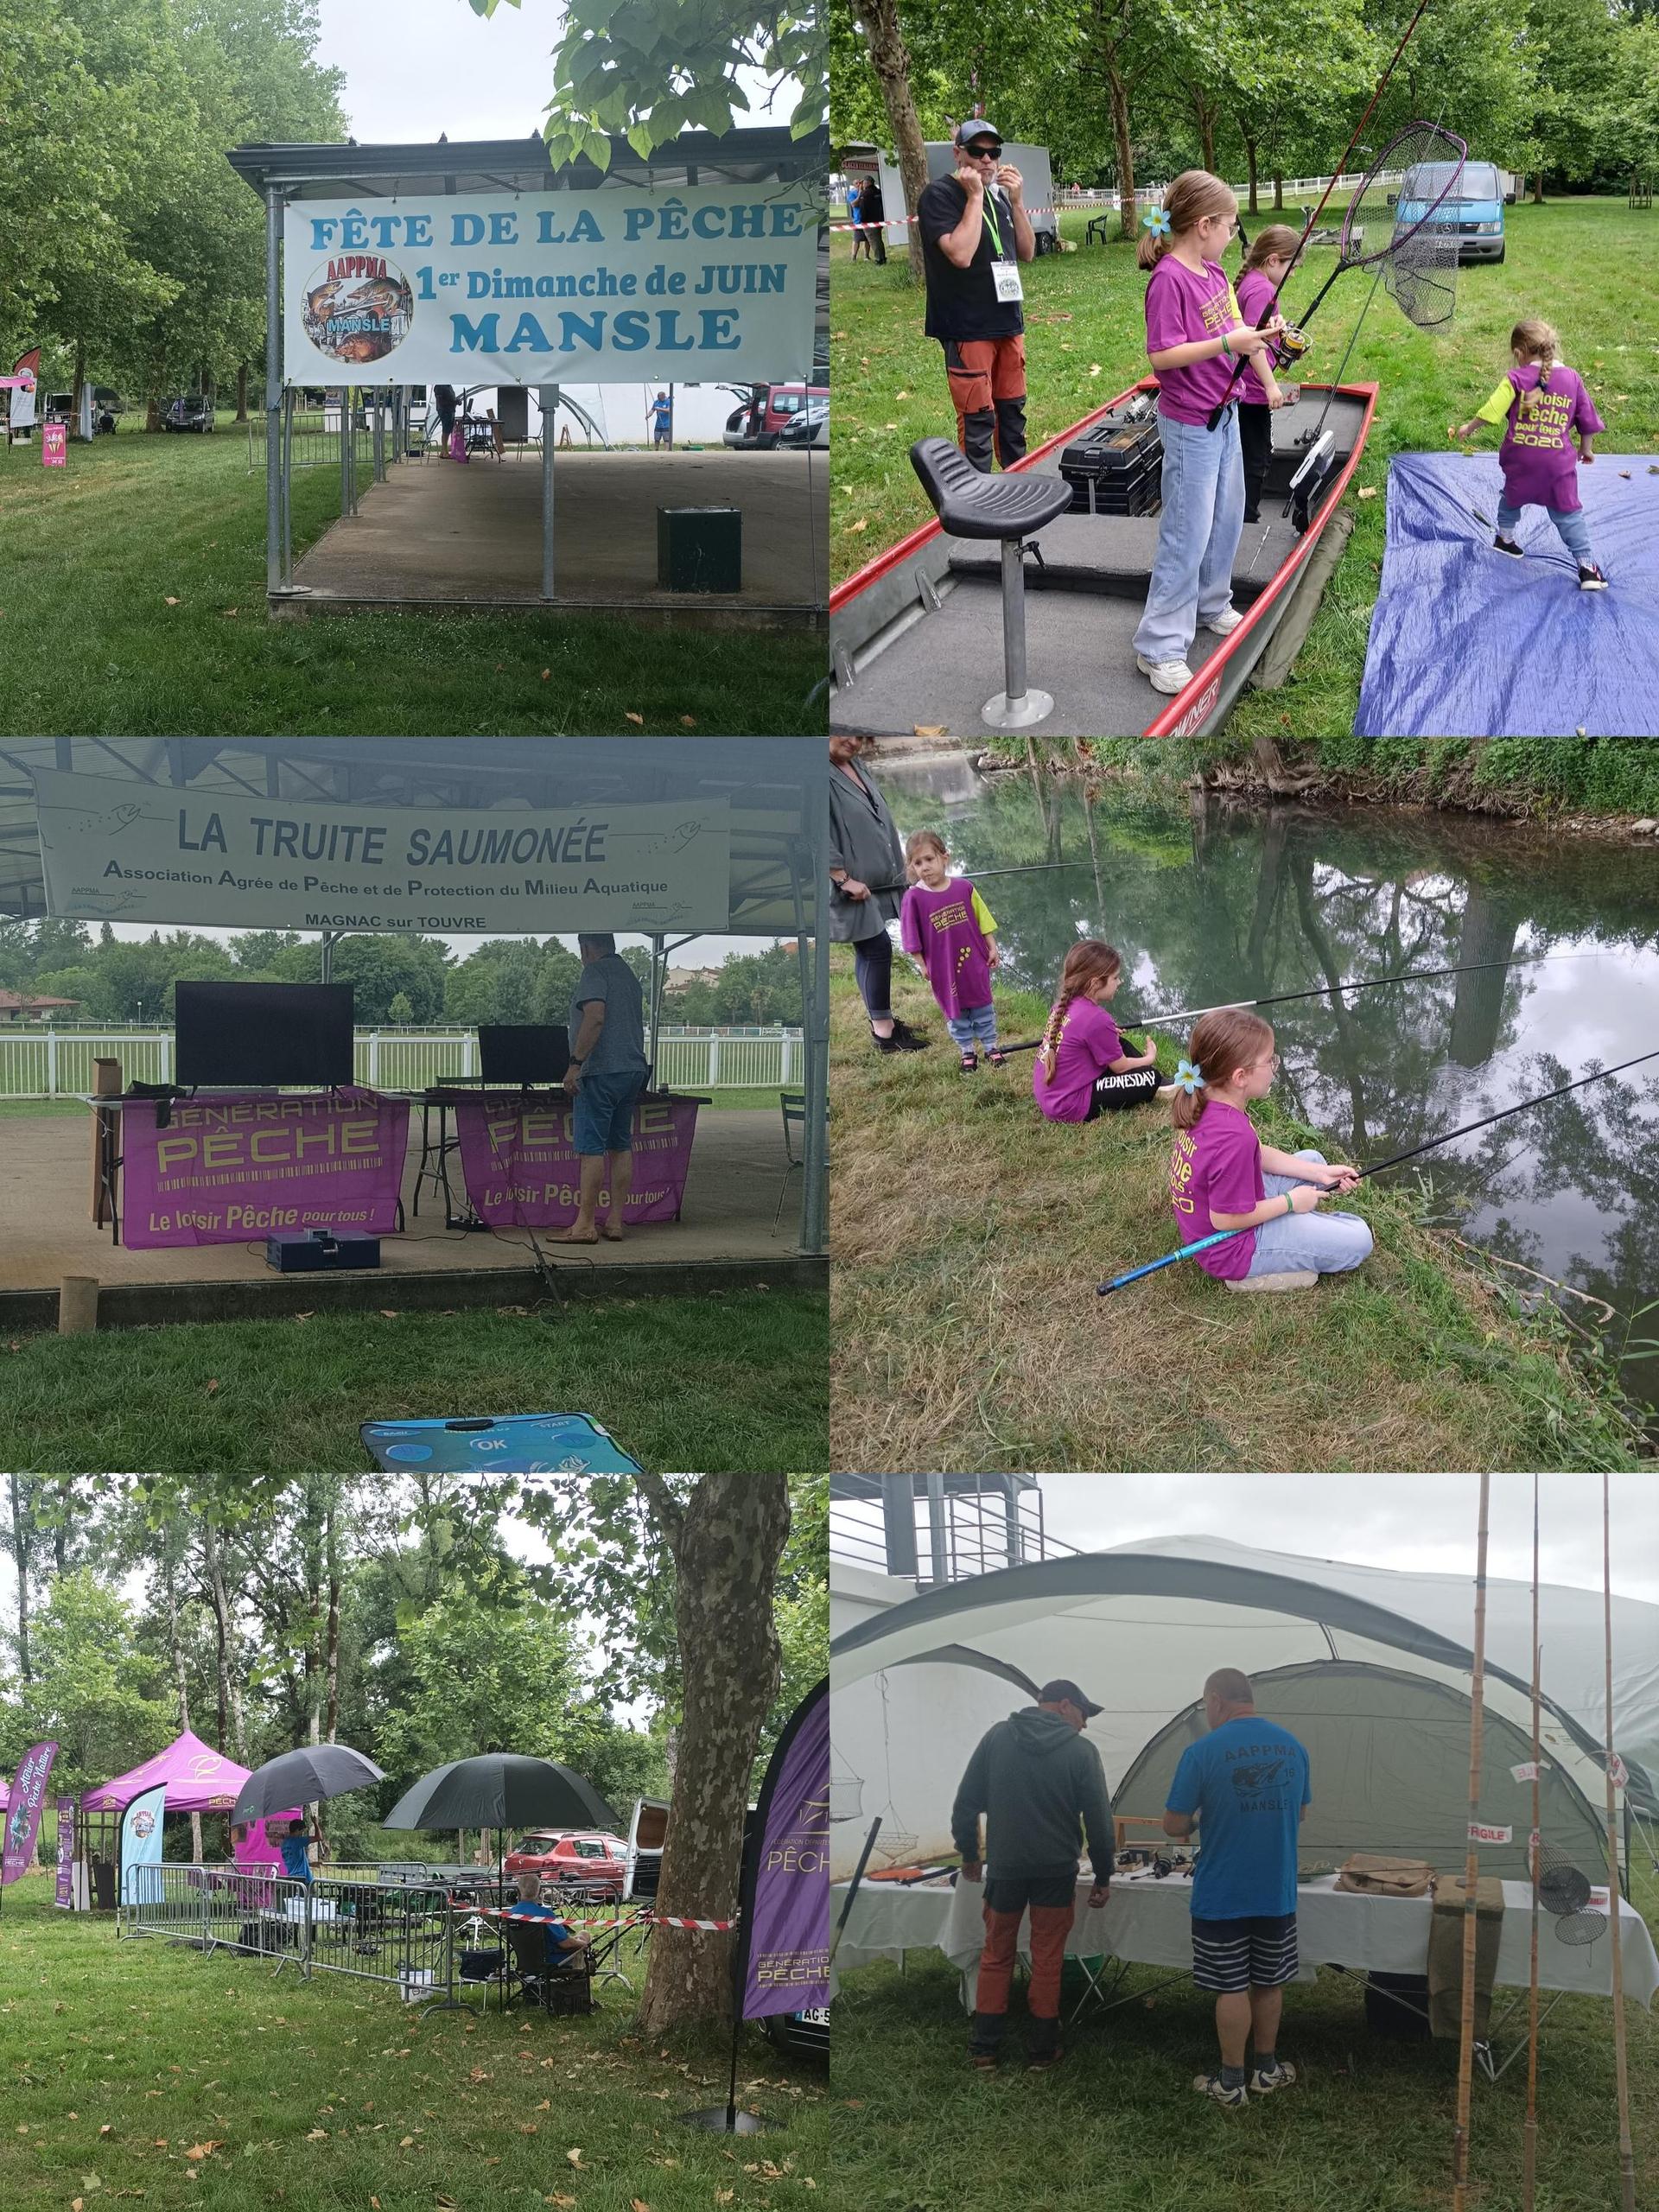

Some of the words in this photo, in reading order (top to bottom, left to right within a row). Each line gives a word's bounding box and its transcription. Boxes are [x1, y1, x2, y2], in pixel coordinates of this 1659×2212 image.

[310, 207, 434, 250] FÊTE
[450, 212, 518, 246] DE
[536, 209, 606, 245] LA
[623, 197, 804, 242] PÊCHE
[327, 255, 388, 283] AAPPMA
[416, 266, 460, 300] 1er
[467, 267, 638, 299] Dimanche
[645, 264, 686, 296] de
[695, 264, 788, 296] JUIN
[327, 318, 391, 333] MANSLE
[449, 308, 742, 354] MANSLE
[1512, 432, 1564, 448] 2020
[1515, 422, 1537, 432] pour
[179, 809, 228, 854] LA
[250, 817, 388, 865] TRUITE
[406, 817, 609, 866] SAUMONÉE
[103, 860, 213, 885] Association
[218, 869, 274, 890] Agrée
[278, 880, 298, 891] de
[303, 875, 359, 895] Pêche
[363, 885, 378, 895] et
[383, 884, 402, 896] de
[407, 880, 495, 897] Protection
[499, 885, 519, 896] du
[524, 879, 578, 895] Milieu
[583, 877, 669, 896] Aquatique
[305, 913, 382, 927] MAGNAC
[386, 917, 414, 927] sur
[416, 916, 487, 929] TOUVRE
[1095, 1070, 1156, 1092] WEDNESDAY
[487, 1101, 677, 1154] PÊE
[156, 1119, 380, 1173] PÊCHE
[484, 1189, 503, 1206] Le
[543, 1183, 611, 1208] Pêce
[149, 1212, 171, 1232] Le
[175, 1209, 222, 1230] loisir
[226, 1204, 299, 1230] Pêche
[302, 1210, 336, 1224] pour
[477, 1439, 508, 1452] OK
[33, 1745, 53, 1778] Nature
[1224, 1744, 1296, 1763] AAPPMA
[20, 1757, 35, 1794] Atelier
[1239, 1798, 1288, 1812] MANSLE
